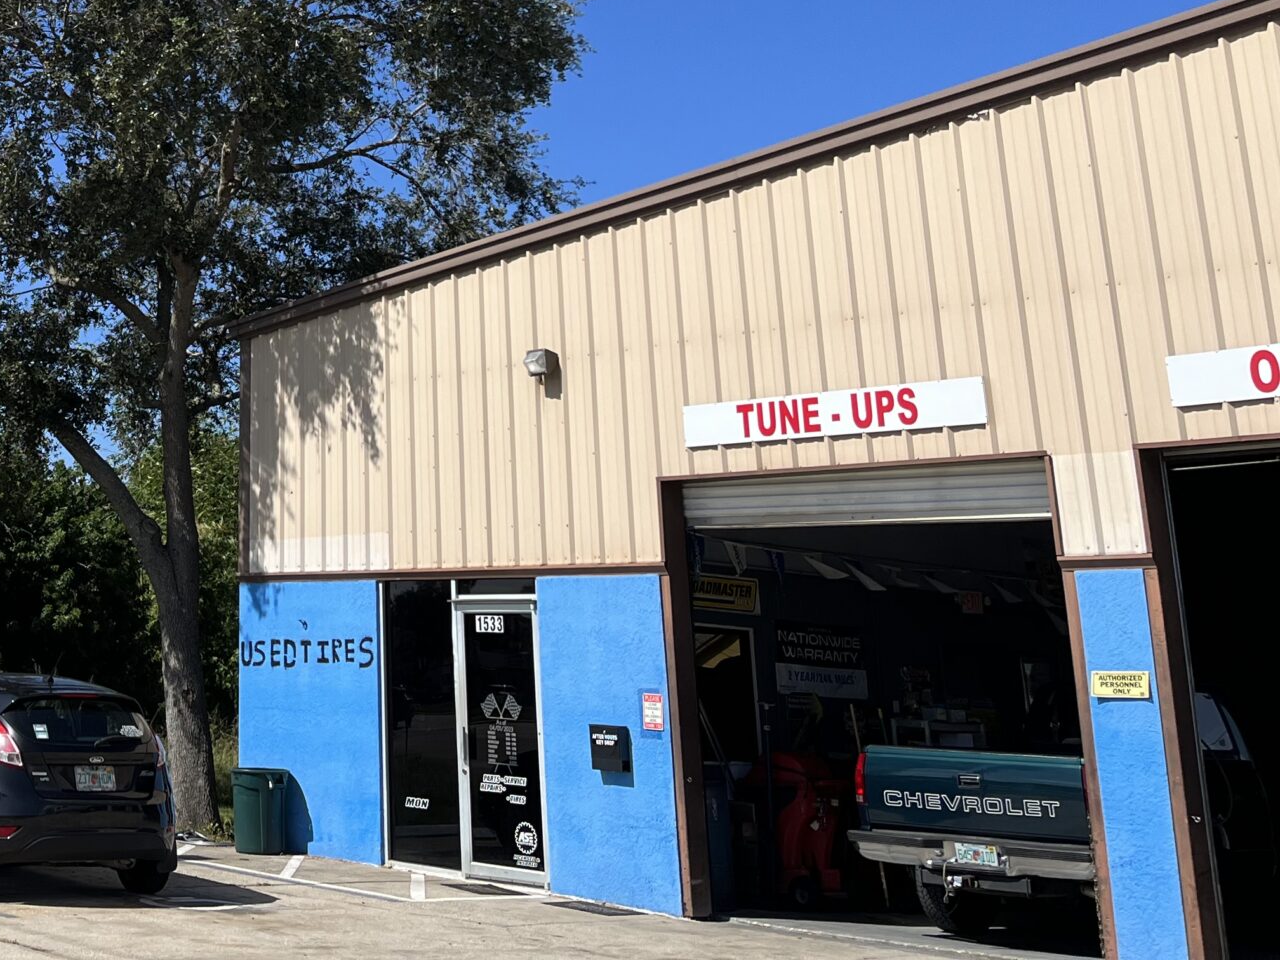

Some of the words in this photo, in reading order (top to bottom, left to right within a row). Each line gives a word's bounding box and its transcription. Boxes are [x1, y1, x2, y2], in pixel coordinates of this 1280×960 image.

[691, 581, 752, 598] OADMASTER
[476, 616, 504, 633] 1533
[777, 630, 861, 649] NATIONWIDE
[782, 645, 858, 664] WARRANTY
[406, 797, 429, 809] MON
[883, 789, 1060, 818] CHEVROLET
